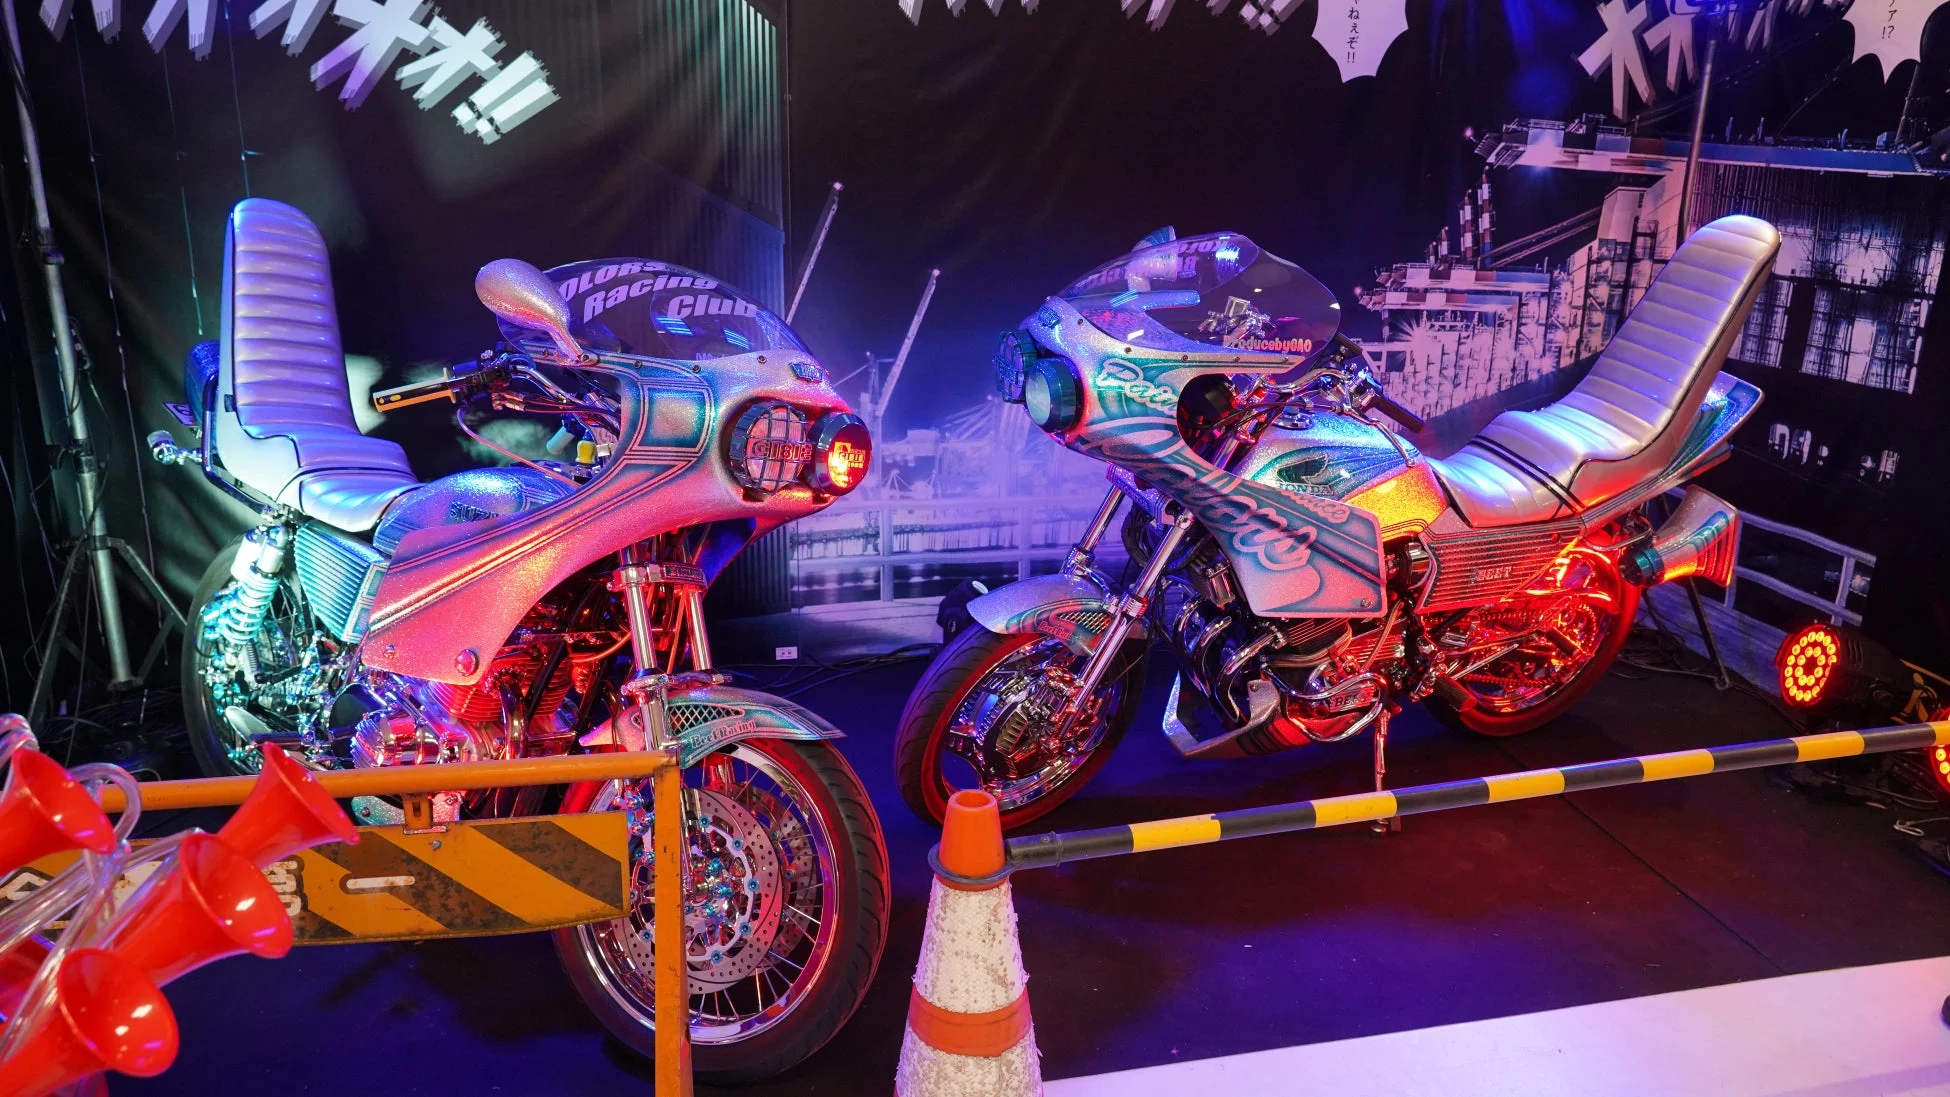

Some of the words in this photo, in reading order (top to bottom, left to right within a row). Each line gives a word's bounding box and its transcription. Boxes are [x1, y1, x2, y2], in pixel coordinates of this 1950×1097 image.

[558, 260, 668, 302] OLORS
[583, 274, 720, 324] Racing
[667, 294, 757, 320] Club
[752, 441, 813, 463] CIBIE
[1477, 566, 1513, 581] BEET
